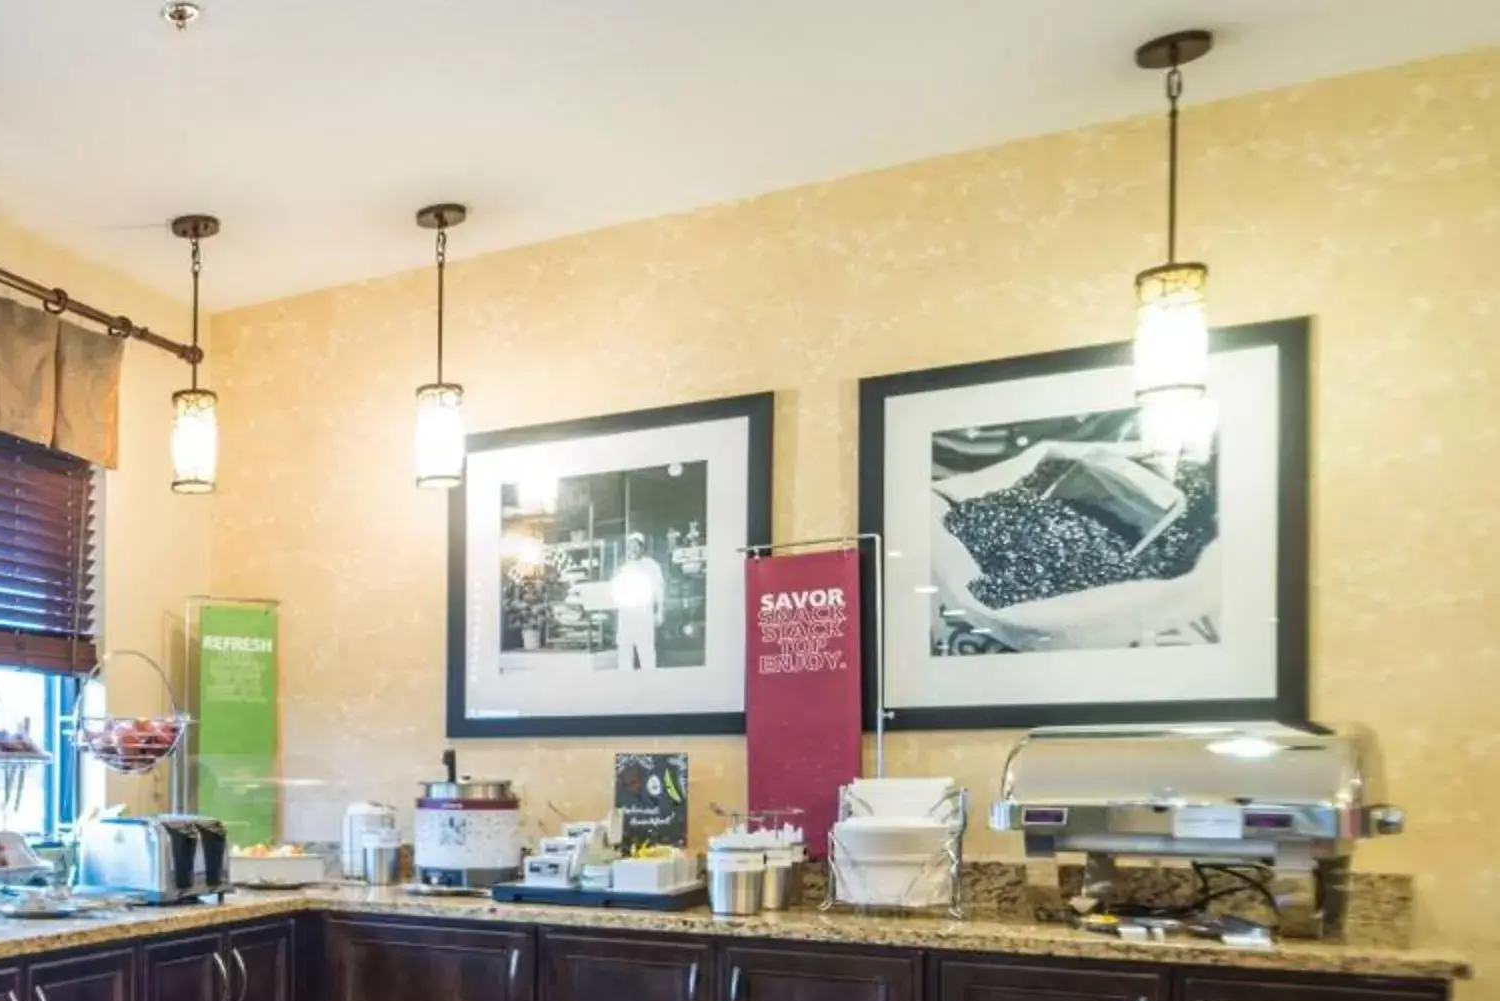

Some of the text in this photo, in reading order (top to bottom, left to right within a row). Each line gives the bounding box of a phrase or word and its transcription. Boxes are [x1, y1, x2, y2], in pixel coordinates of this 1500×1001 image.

[760, 588, 846, 612] SAVOR
[758, 605, 847, 628] SNACK
[761, 620, 845, 643] STACK
[202, 635, 273, 653] REFRESH
[778, 635, 828, 656] TOP
[759, 651, 847, 675] ENJOY.
